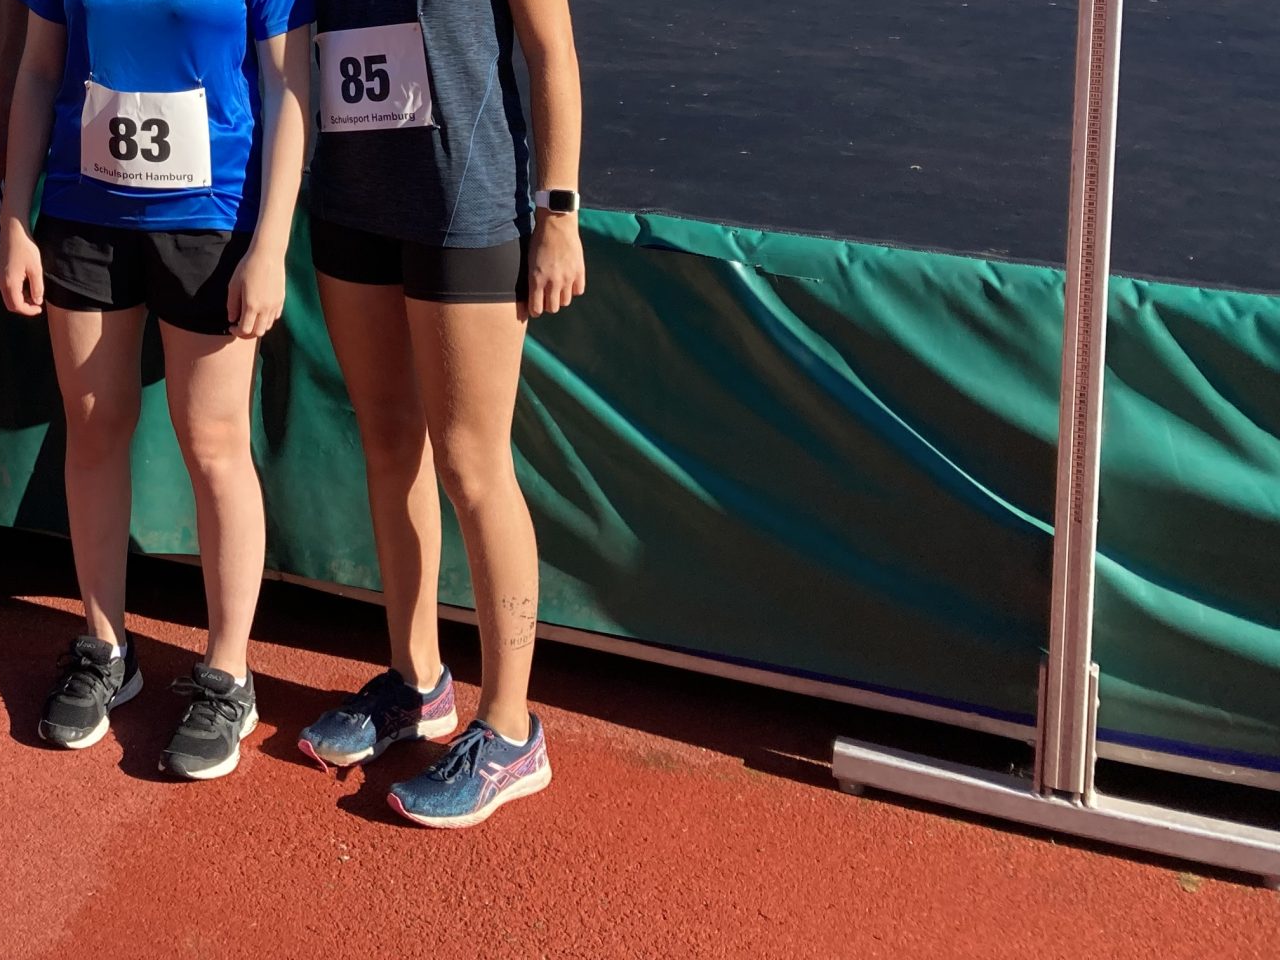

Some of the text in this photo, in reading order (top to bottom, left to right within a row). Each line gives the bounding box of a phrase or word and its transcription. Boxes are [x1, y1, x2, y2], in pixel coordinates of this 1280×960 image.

[339, 53, 390, 104] 85
[330, 111, 417, 126] Schulsport Hamburg
[108, 116, 171, 163] 83
[93, 163, 194, 182] Schulsport Hamburg
